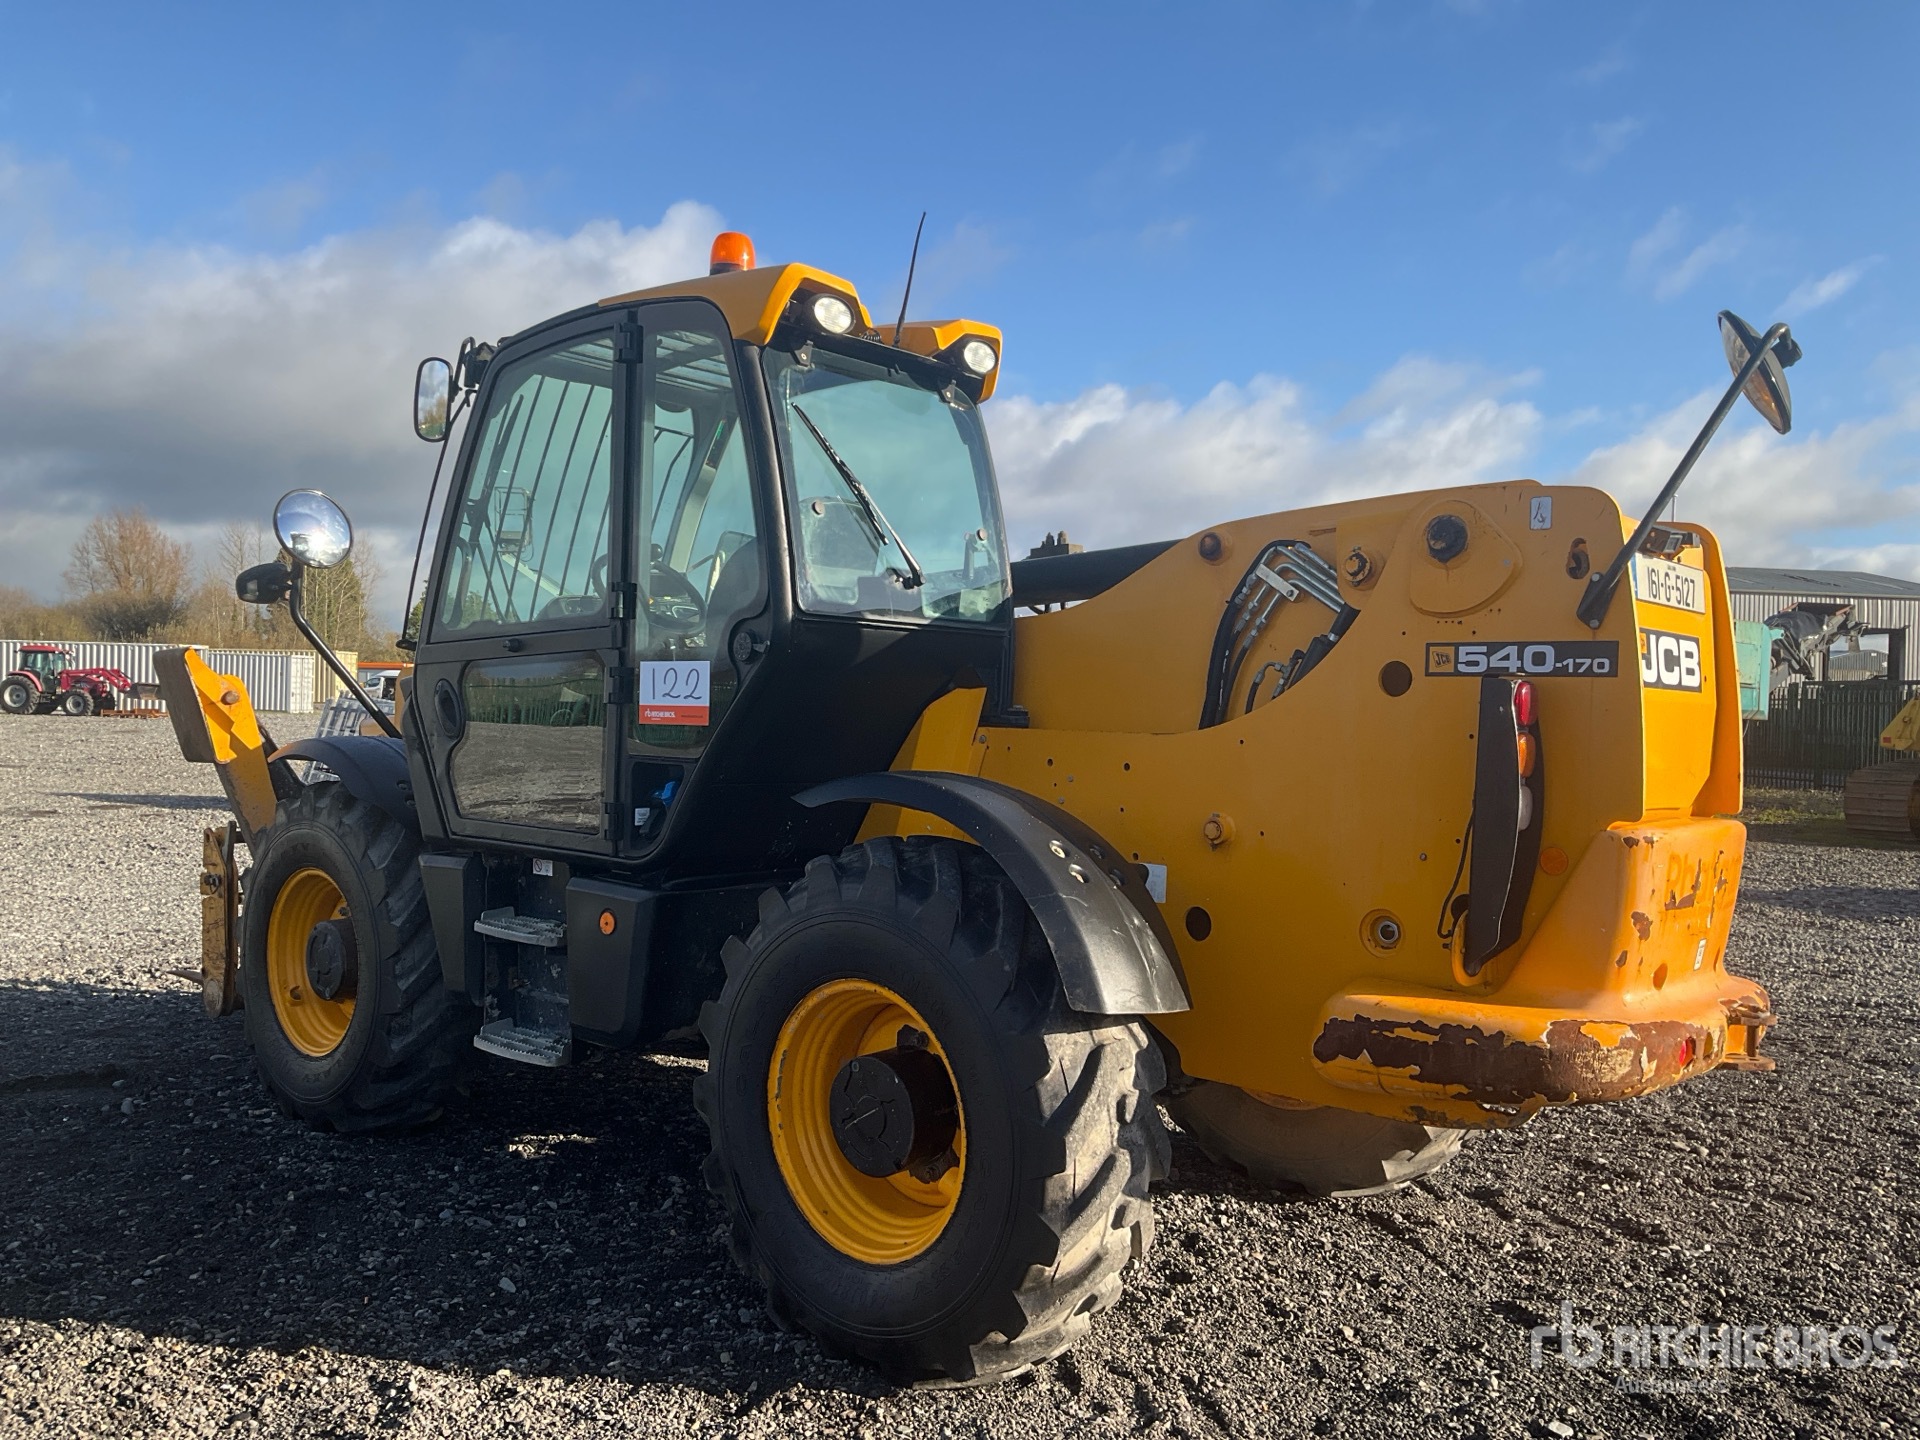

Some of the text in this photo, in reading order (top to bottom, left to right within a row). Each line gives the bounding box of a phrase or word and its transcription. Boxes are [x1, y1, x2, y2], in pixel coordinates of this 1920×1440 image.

[1647, 566, 1695, 609] 161-G-5127
[1434, 651, 1452, 666] JCB
[1457, 645, 1610, 673] 540-170
[1641, 634, 1700, 687] JCB
[652, 667, 702, 700] 122
